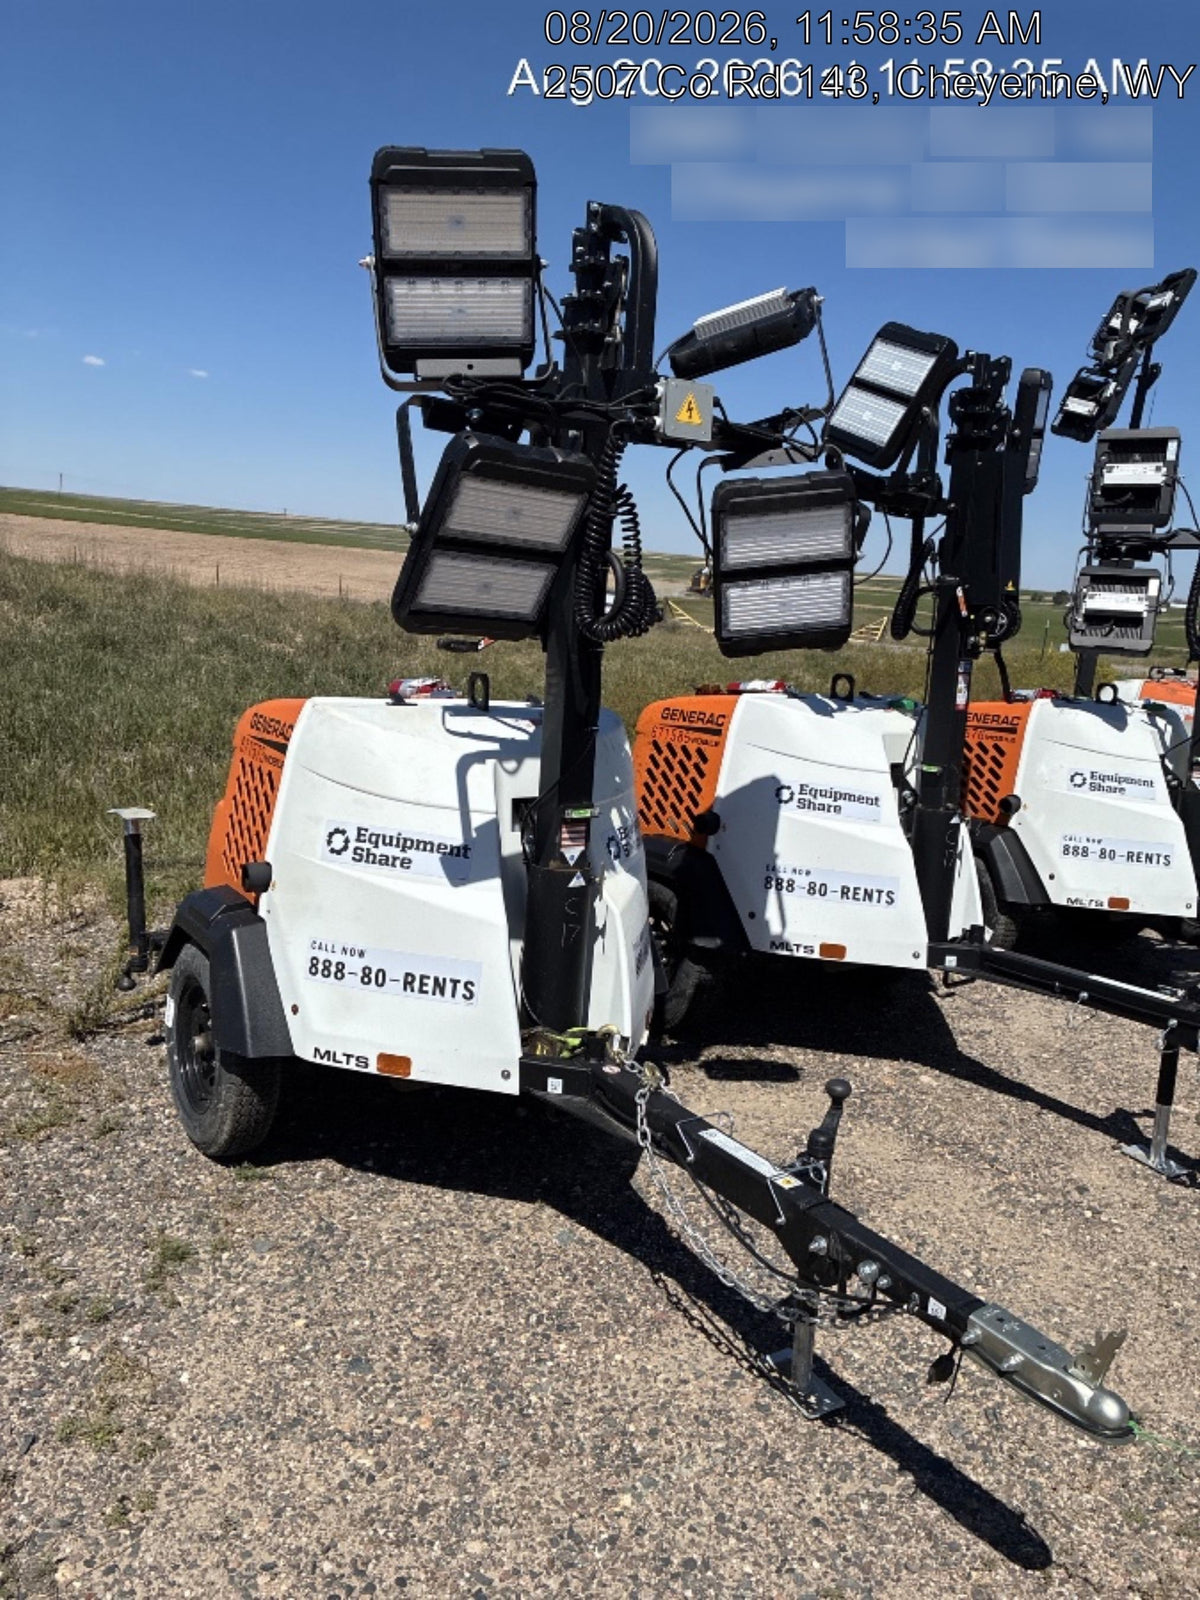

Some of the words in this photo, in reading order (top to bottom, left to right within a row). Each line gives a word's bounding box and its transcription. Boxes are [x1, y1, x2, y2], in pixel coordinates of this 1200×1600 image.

[661, 707, 726, 727] GENERAC
[966, 712, 1021, 726] ENERAC
[1089, 782, 1126, 795] Share
[1090, 771, 1155, 788] Equipment
[796, 797, 842, 814] Share
[798, 783, 880, 807] Equipment
[355, 826, 472, 859] Equipment
[351, 846, 412, 869] Share
[1063, 844, 1171, 867] 888-80-RENTS
[764, 875, 895, 905] 888-80-RENTS
[311, 940, 336, 954] CALL
[341, 946, 367, 958] NOW
[769, 940, 815, 955] MLTS
[308, 956, 476, 1001] 888-80-RENTS
[313, 1046, 370, 1069] MLTS
